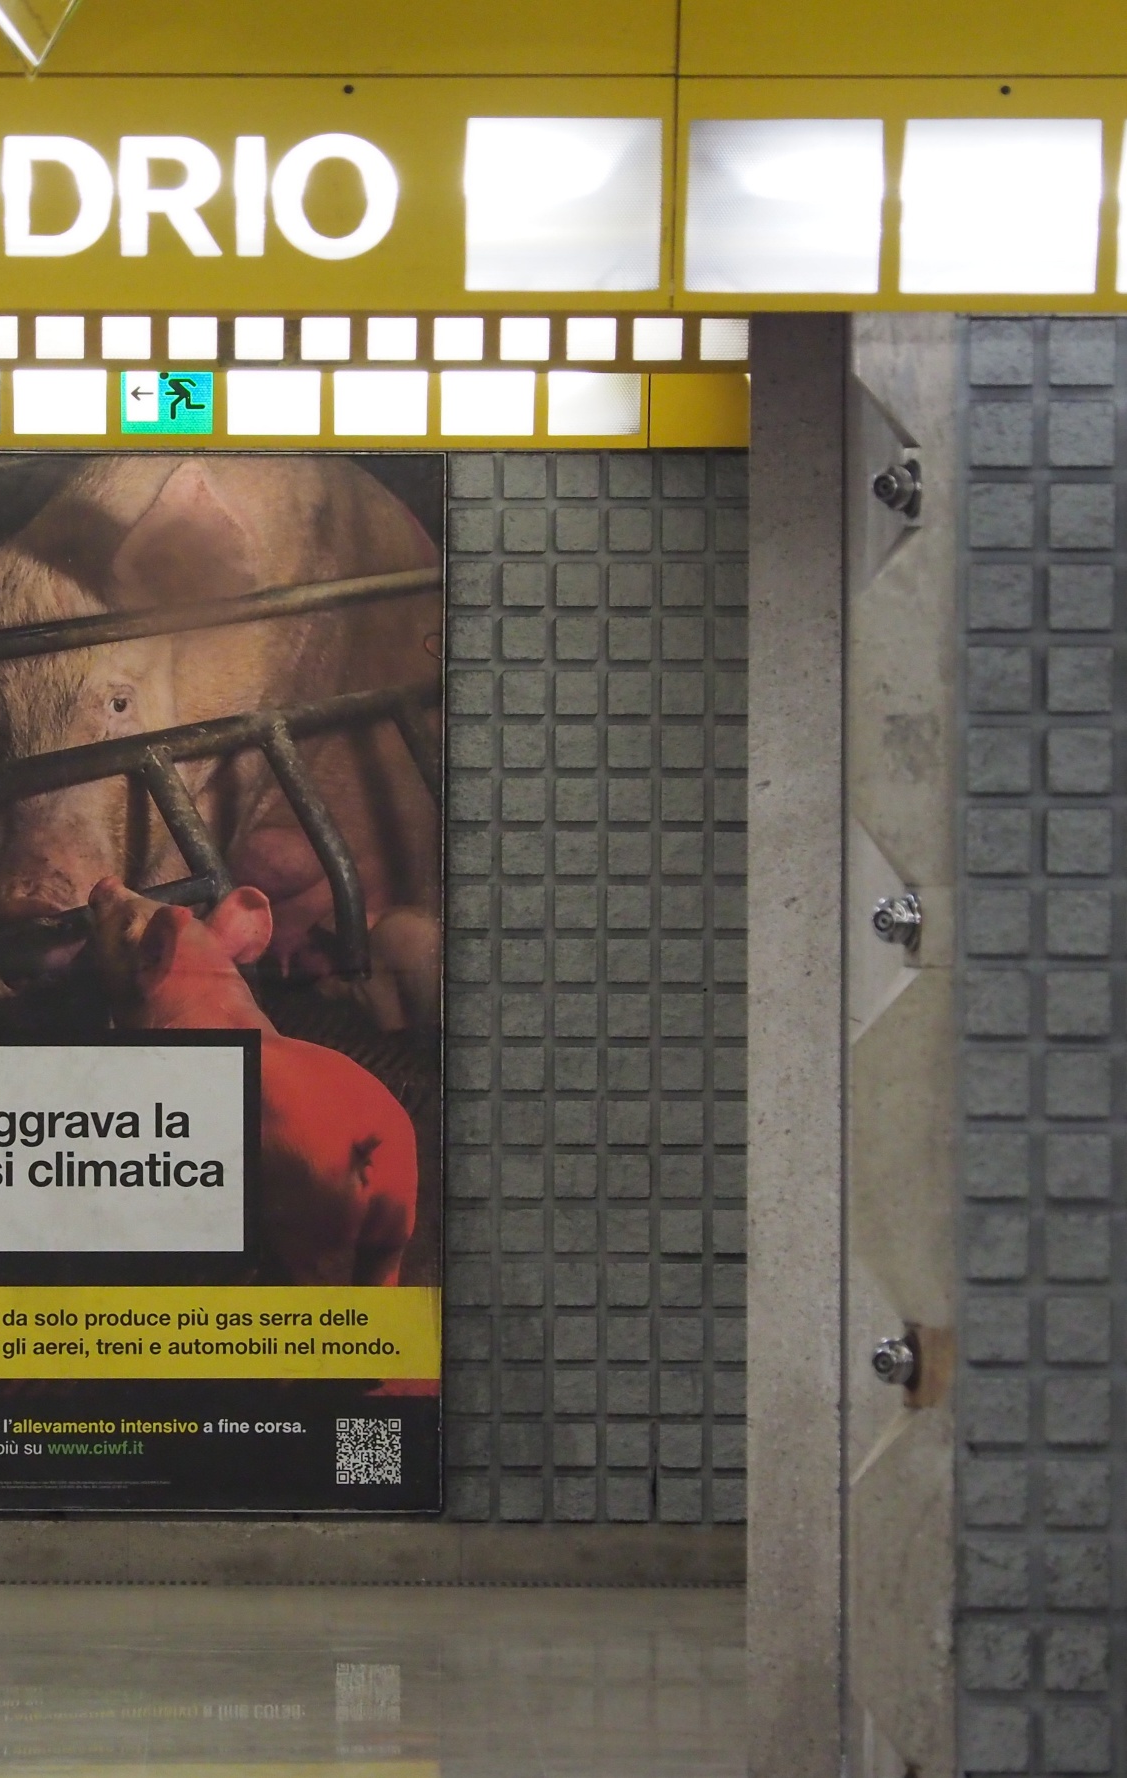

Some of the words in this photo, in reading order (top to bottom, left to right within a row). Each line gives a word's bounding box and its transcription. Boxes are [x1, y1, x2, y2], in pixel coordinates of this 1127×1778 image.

[155, 1102, 190, 1138] la
[27, 1151, 225, 1188] climatica
[3, 1310, 27, 1326] da
[35, 1309, 78, 1326] solo
[86, 1309, 170, 1331] produce
[178, 1308, 208, 1330] più
[216, 1313, 252, 1331] gas
[260, 1313, 312, 1326] serra
[320, 1309, 368, 1326] delle
[3, 1338, 25, 1360] gli
[33, 1338, 89, 1359] aerei,
[96, 1338, 142, 1355] treni
[149, 1342, 162, 1355] e
[169, 1338, 277, 1355] automobili
[285, 1338, 314, 1355] nel
[322, 1338, 400, 1355] mondo.
[120, 1418, 199, 1434] intensivo
[203, 1422, 213, 1434] a
[218, 1418, 250, 1434] fine
[255, 1422, 307, 1434] corsa.
[24, 1444, 42, 1455] su
[47, 1440, 144, 1455] www.ciwf.it
